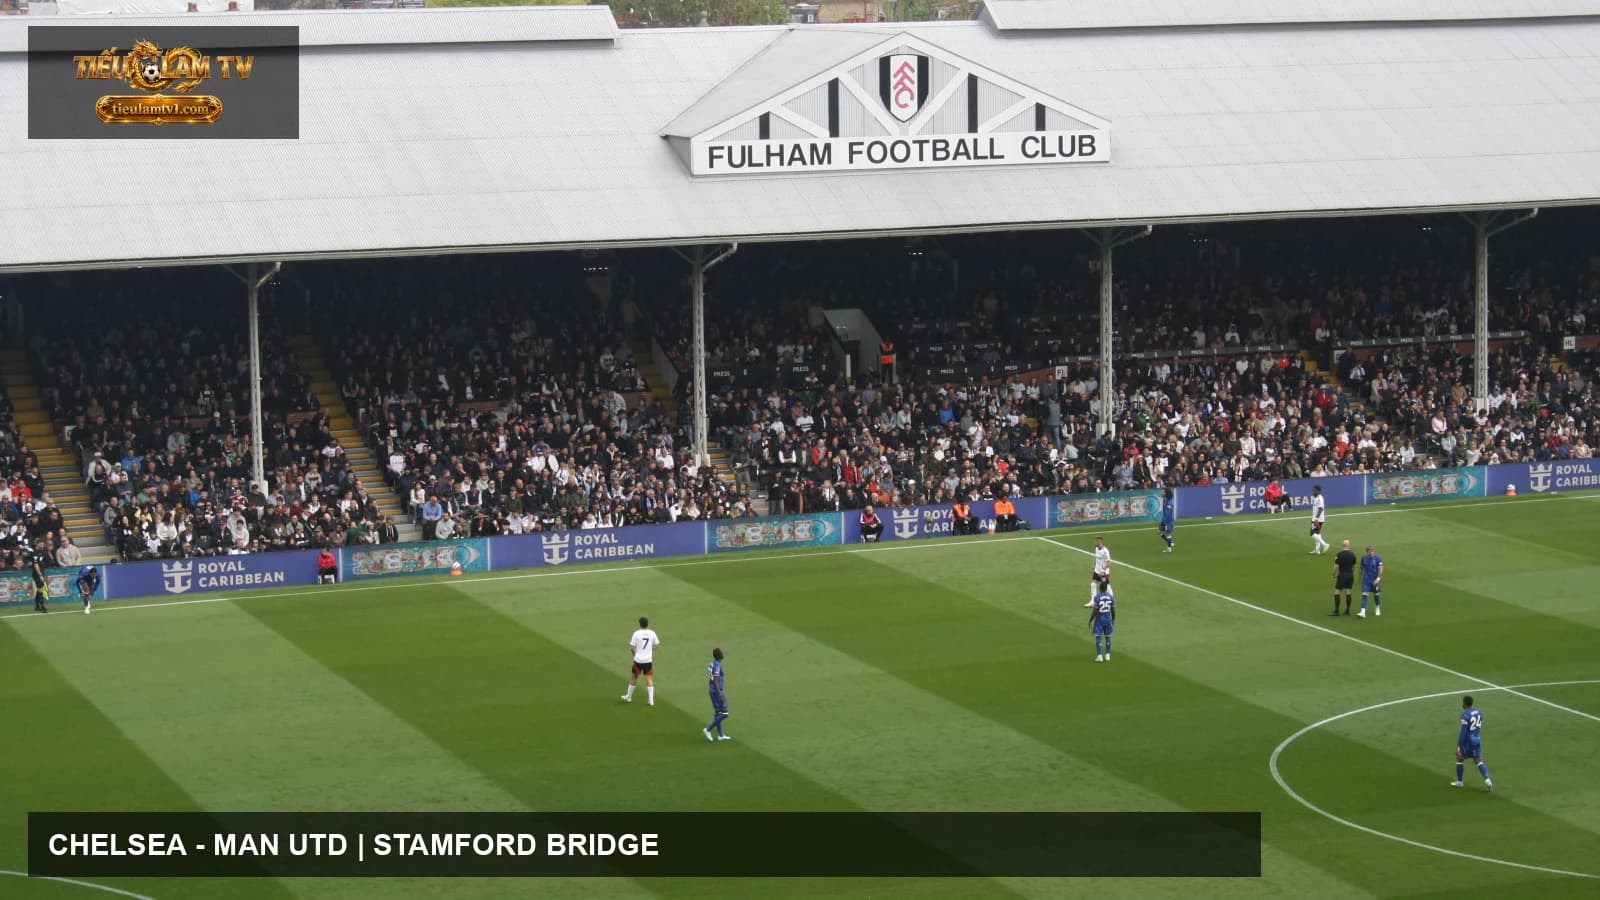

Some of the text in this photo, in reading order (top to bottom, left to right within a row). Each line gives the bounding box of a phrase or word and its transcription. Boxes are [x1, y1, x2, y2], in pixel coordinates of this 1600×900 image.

[893, 61, 915, 109] FFC
[708, 134, 1096, 168] FULHAM FOOTBALL CLUB
[1556, 464, 1592, 476] ROYAL
[574, 533, 618, 545] ROYAL
[574, 543, 654, 559] CARIBBEAN
[198, 561, 245, 574] ROYAL
[198, 571, 284, 588] CARIBBEAN
[1098, 600, 1112, 613] 25
[642, 638, 650, 650] 7
[1469, 714, 1482, 731] 24
